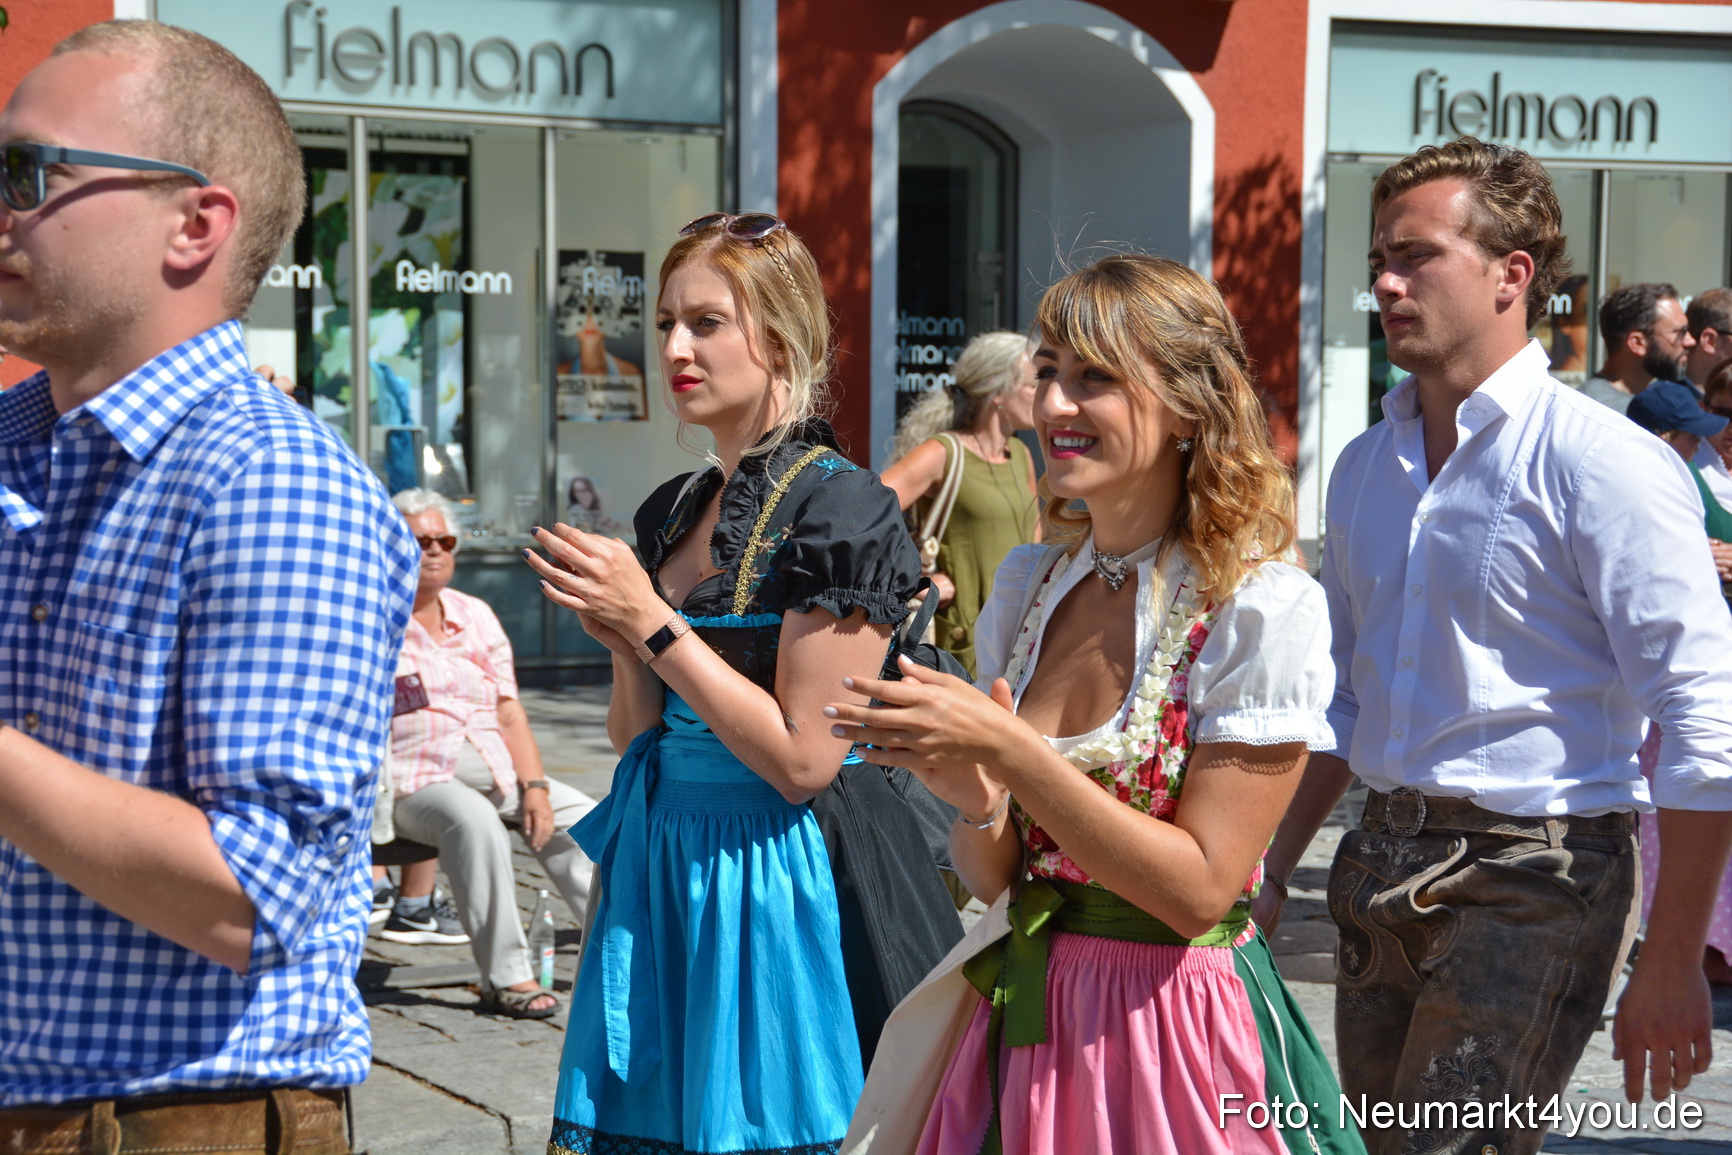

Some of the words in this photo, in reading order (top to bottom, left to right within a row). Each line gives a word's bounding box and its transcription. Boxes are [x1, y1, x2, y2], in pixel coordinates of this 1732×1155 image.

[284, 0, 615, 98] fielmann
[1412, 67, 1659, 145] fielmann
[396, 259, 512, 295] fielmann
